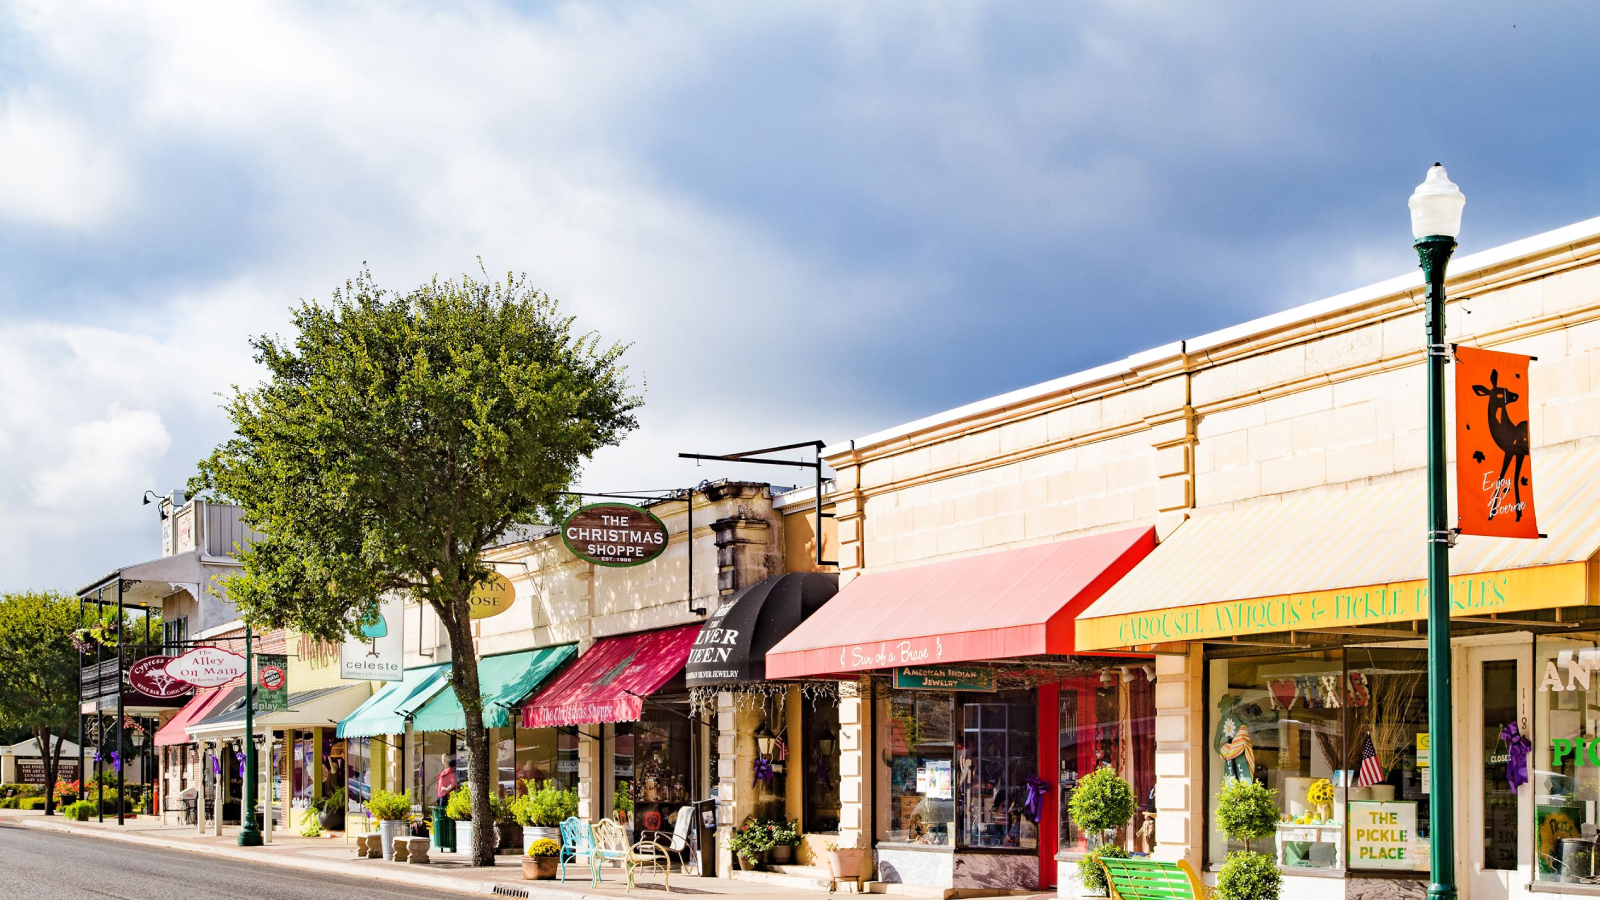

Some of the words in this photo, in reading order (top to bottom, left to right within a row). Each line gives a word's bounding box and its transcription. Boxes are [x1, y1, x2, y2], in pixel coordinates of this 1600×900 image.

[1482, 470, 1511, 500] Enjoy
[1487, 496, 1526, 517] Boerne
[602, 515, 629, 527] THE
[566, 527, 664, 545] CHRISTMAS
[588, 544, 644, 557] SHOPPE
[478, 582, 506, 592] VIN
[470, 595, 501, 607] OSE
[1119, 609, 1204, 643] CAROUSEL
[1211, 596, 1303, 633] ANTIQUES
[1311, 596, 1326, 621] &
[1416, 575, 1507, 613] PKLES
[694, 628, 739, 645] LVER
[686, 647, 733, 664] UEEN
[851, 646, 873, 667] Sun
[875, 642, 887, 666] of
[888, 652, 896, 663] a
[897, 640, 930, 663] Brave
[134, 658, 165, 675] Cypress
[192, 656, 225, 666] Alley
[266, 660, 287, 670] shop
[346, 661, 399, 671] celeste
[180, 669, 198, 677] On
[203, 667, 238, 675] Main
[265, 673, 280, 683] mile
[712, 669, 739, 678] JEWELRY
[902, 667, 946, 678] AMERICAN
[948, 668, 977, 678] INDIAN
[1538, 658, 1600, 692] AN
[137, 683, 150, 693] WINE
[922, 677, 958, 687] JEWELRY
[258, 702, 278, 711] play
[1369, 811, 1398, 825] THE
[1356, 829, 1408, 843] PICKLE
[1360, 847, 1407, 860] PLACE
